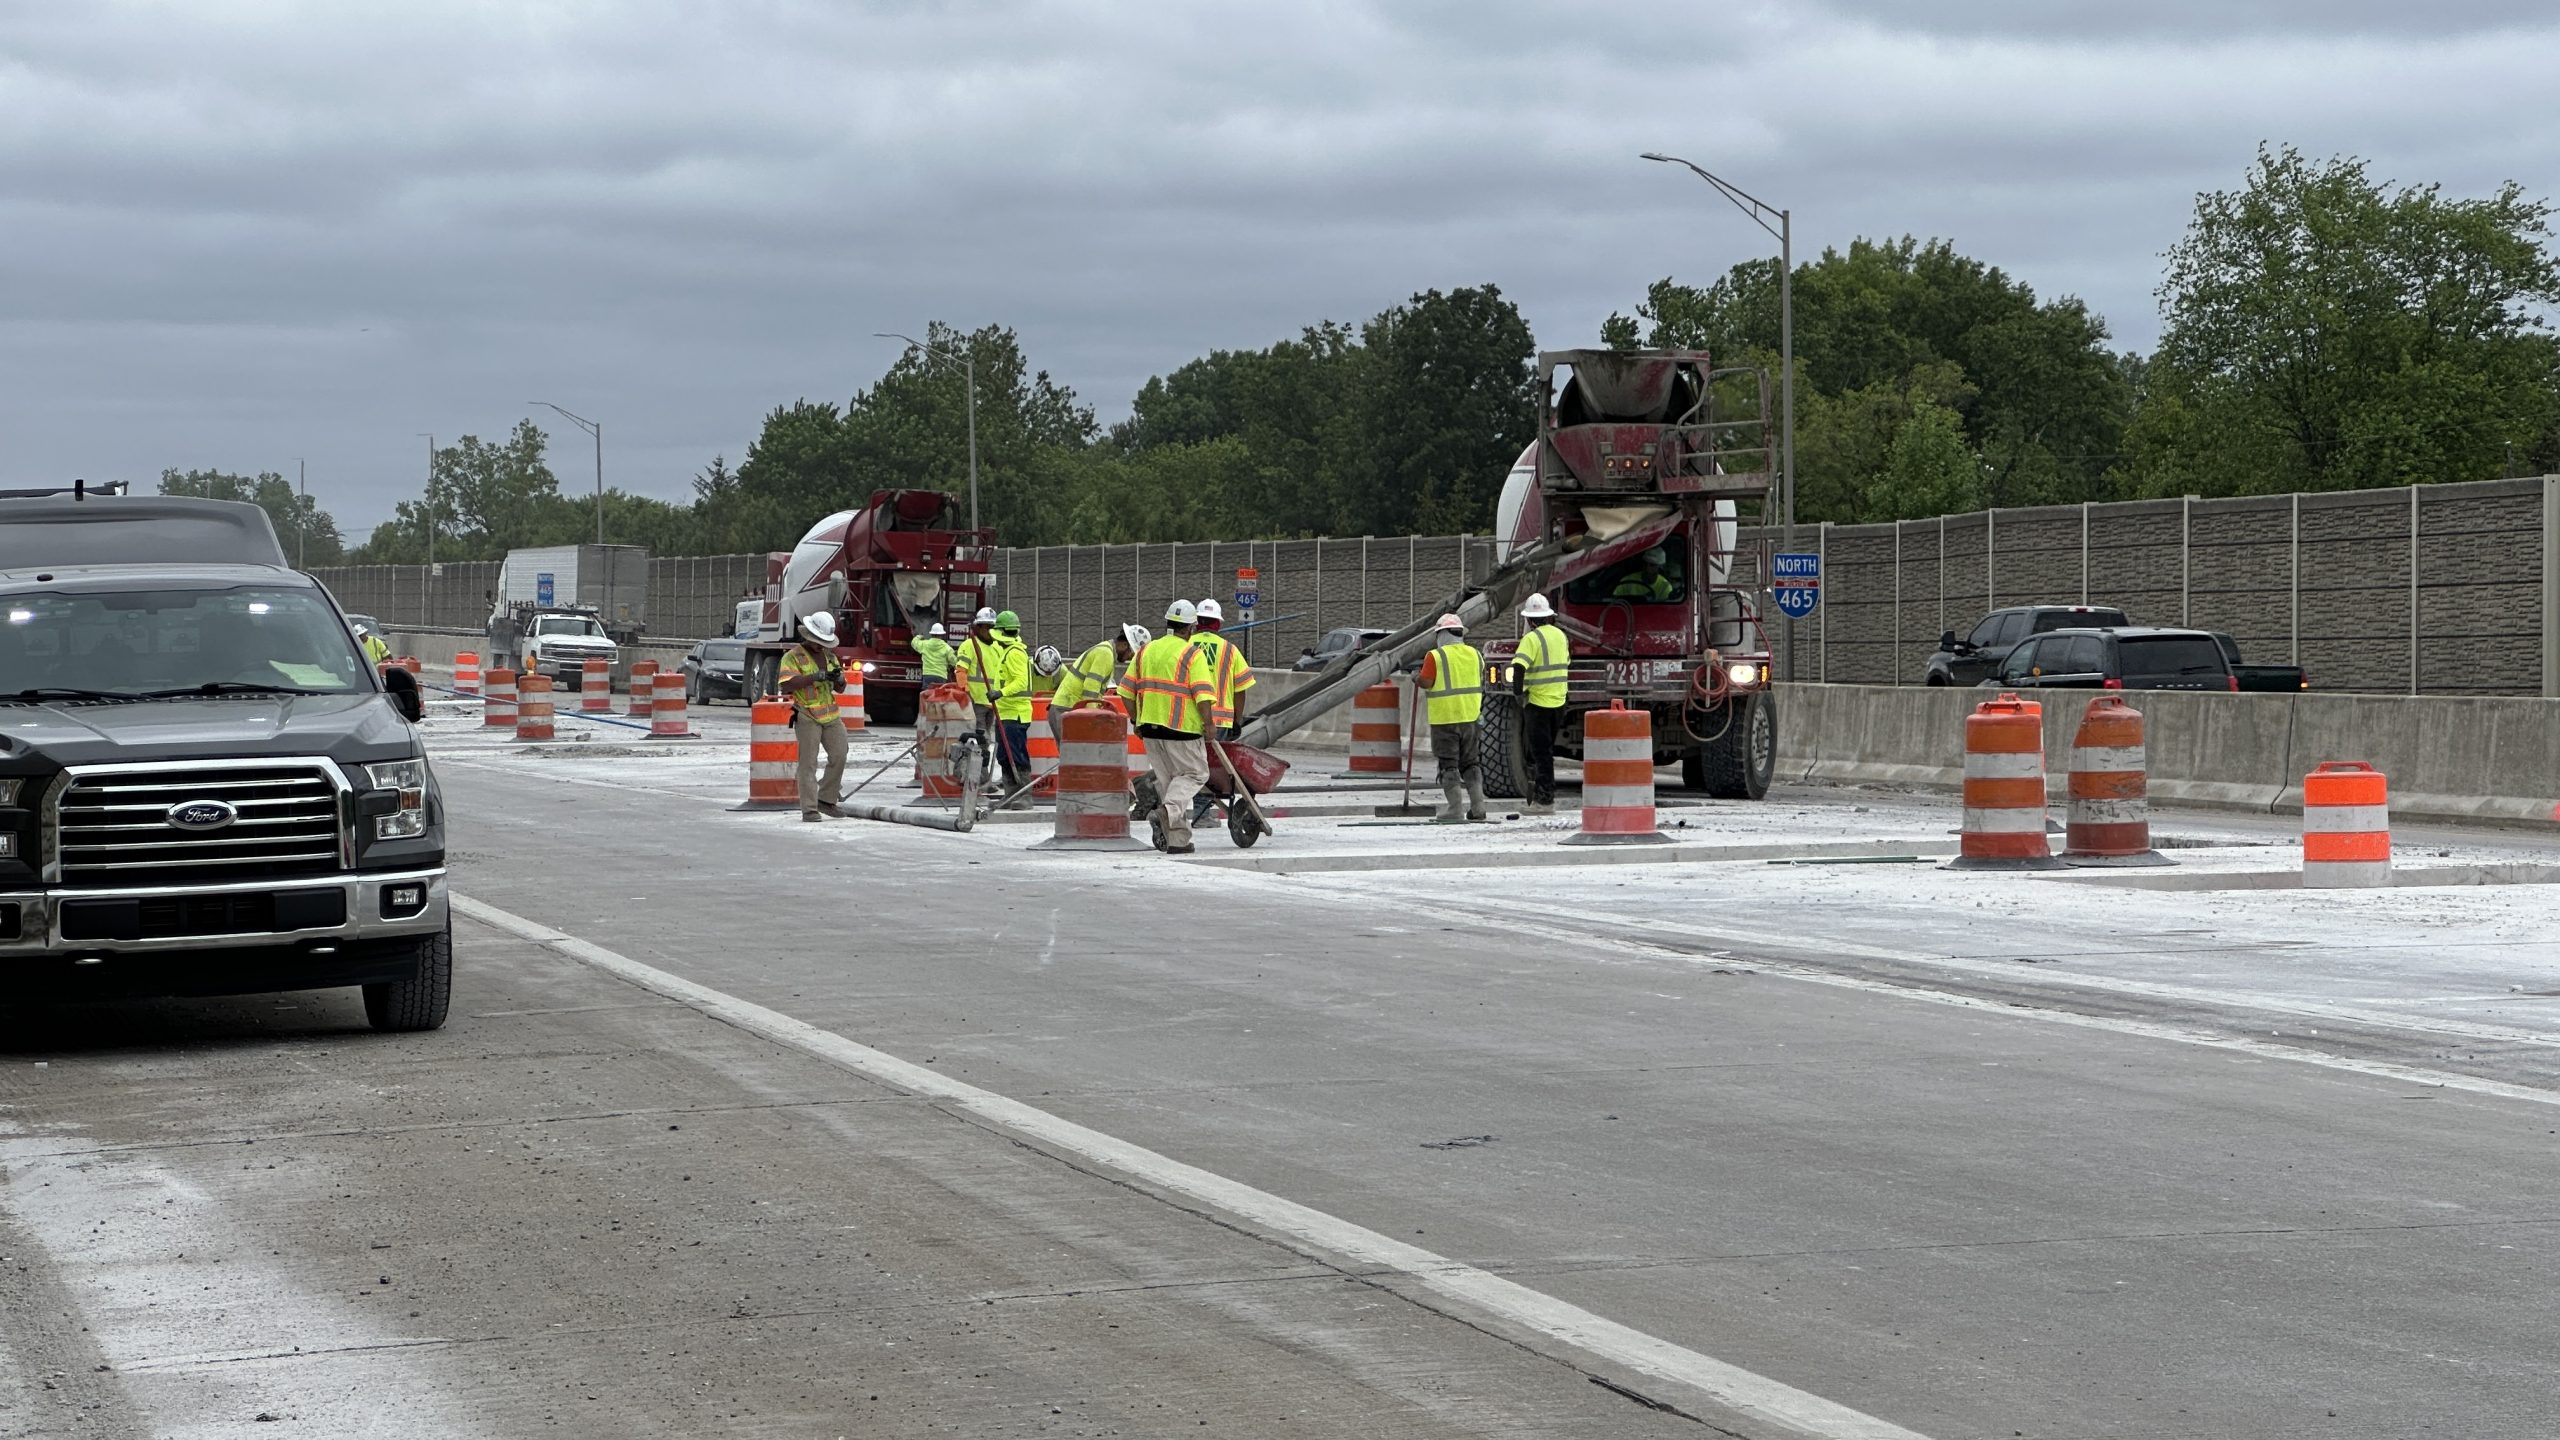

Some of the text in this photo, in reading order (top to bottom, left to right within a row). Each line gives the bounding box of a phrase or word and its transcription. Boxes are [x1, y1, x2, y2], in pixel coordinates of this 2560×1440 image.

[1777, 557, 1816, 572] NORTH
[538, 586, 552, 595] 465
[1238, 594, 1257, 604] 465
[1780, 590, 1813, 608] 465
[1606, 662, 1650, 684] 2235
[185, 807, 220, 822] Ford
